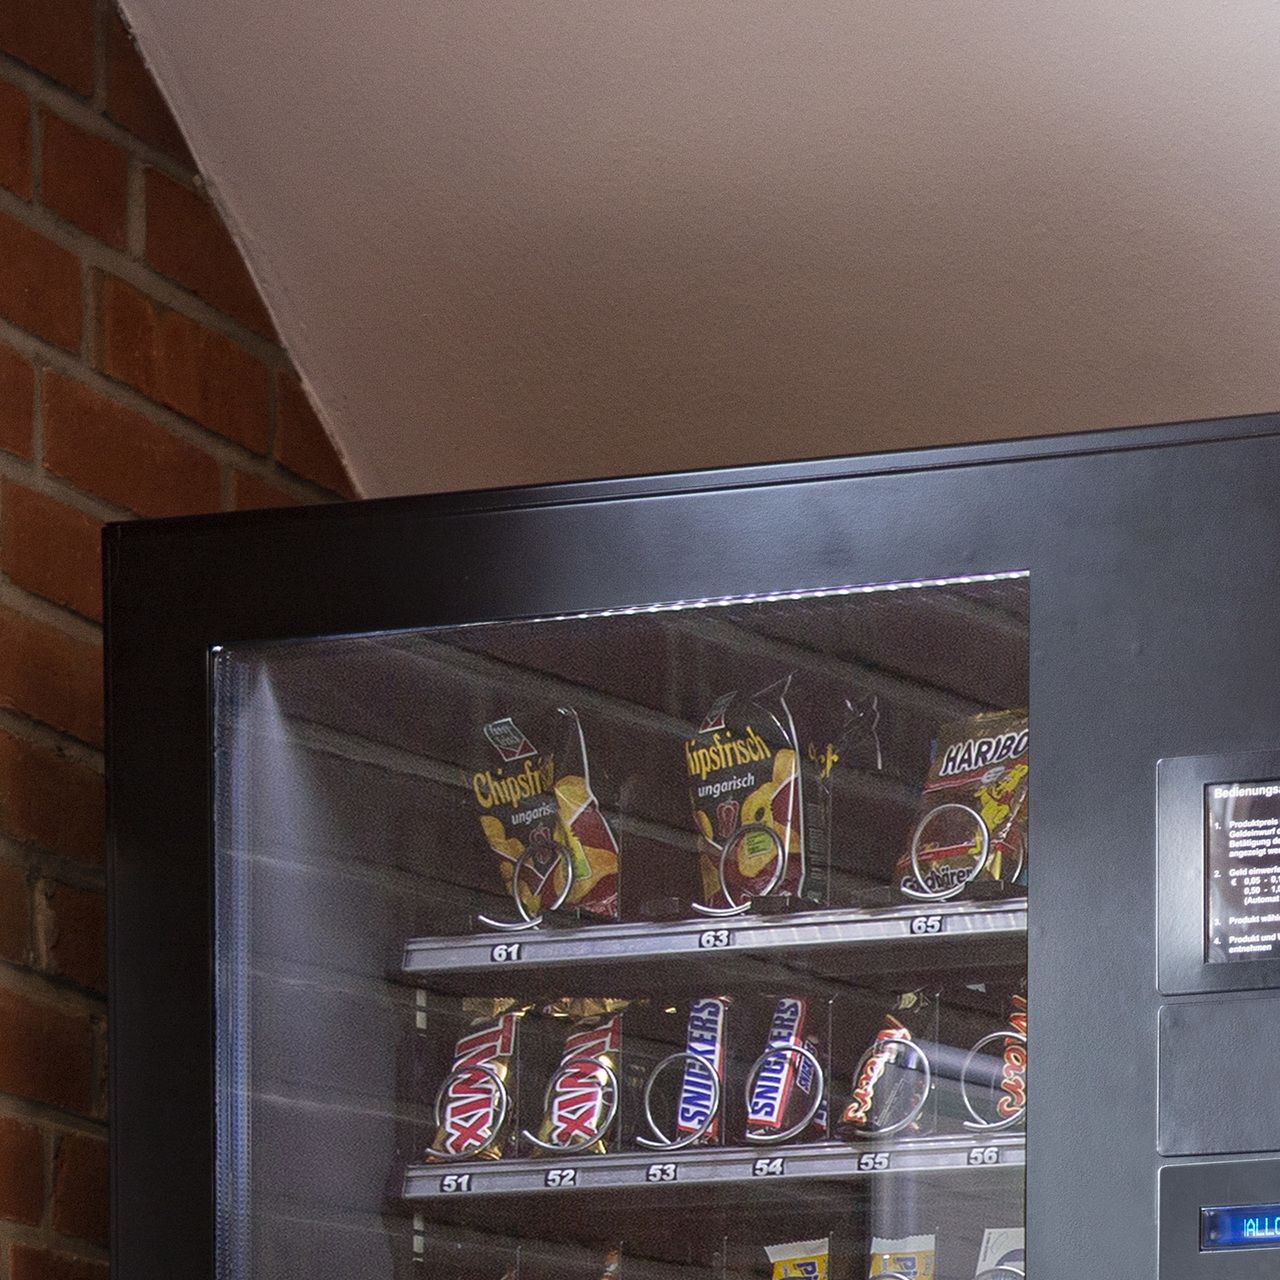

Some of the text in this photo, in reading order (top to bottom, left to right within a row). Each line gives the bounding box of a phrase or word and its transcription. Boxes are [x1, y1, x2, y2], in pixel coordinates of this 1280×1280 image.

[939, 729, 1028, 776] HARIBO
[698, 773, 755, 798] ungarisch
[511, 803, 556, 825] ungaris
[1229, 868, 1248, 877] Geld
[1229, 915, 1260, 925] Produkt
[493, 916, 941, 961] 61 63 65
[1229, 935, 1260, 944] Produkt
[1261, 932, 1277, 941] und
[446, 1012, 516, 1154] TWIX
[553, 1015, 621, 1148] TWIX
[442, 1148, 998, 1192] 51 52 53 54 55 56
